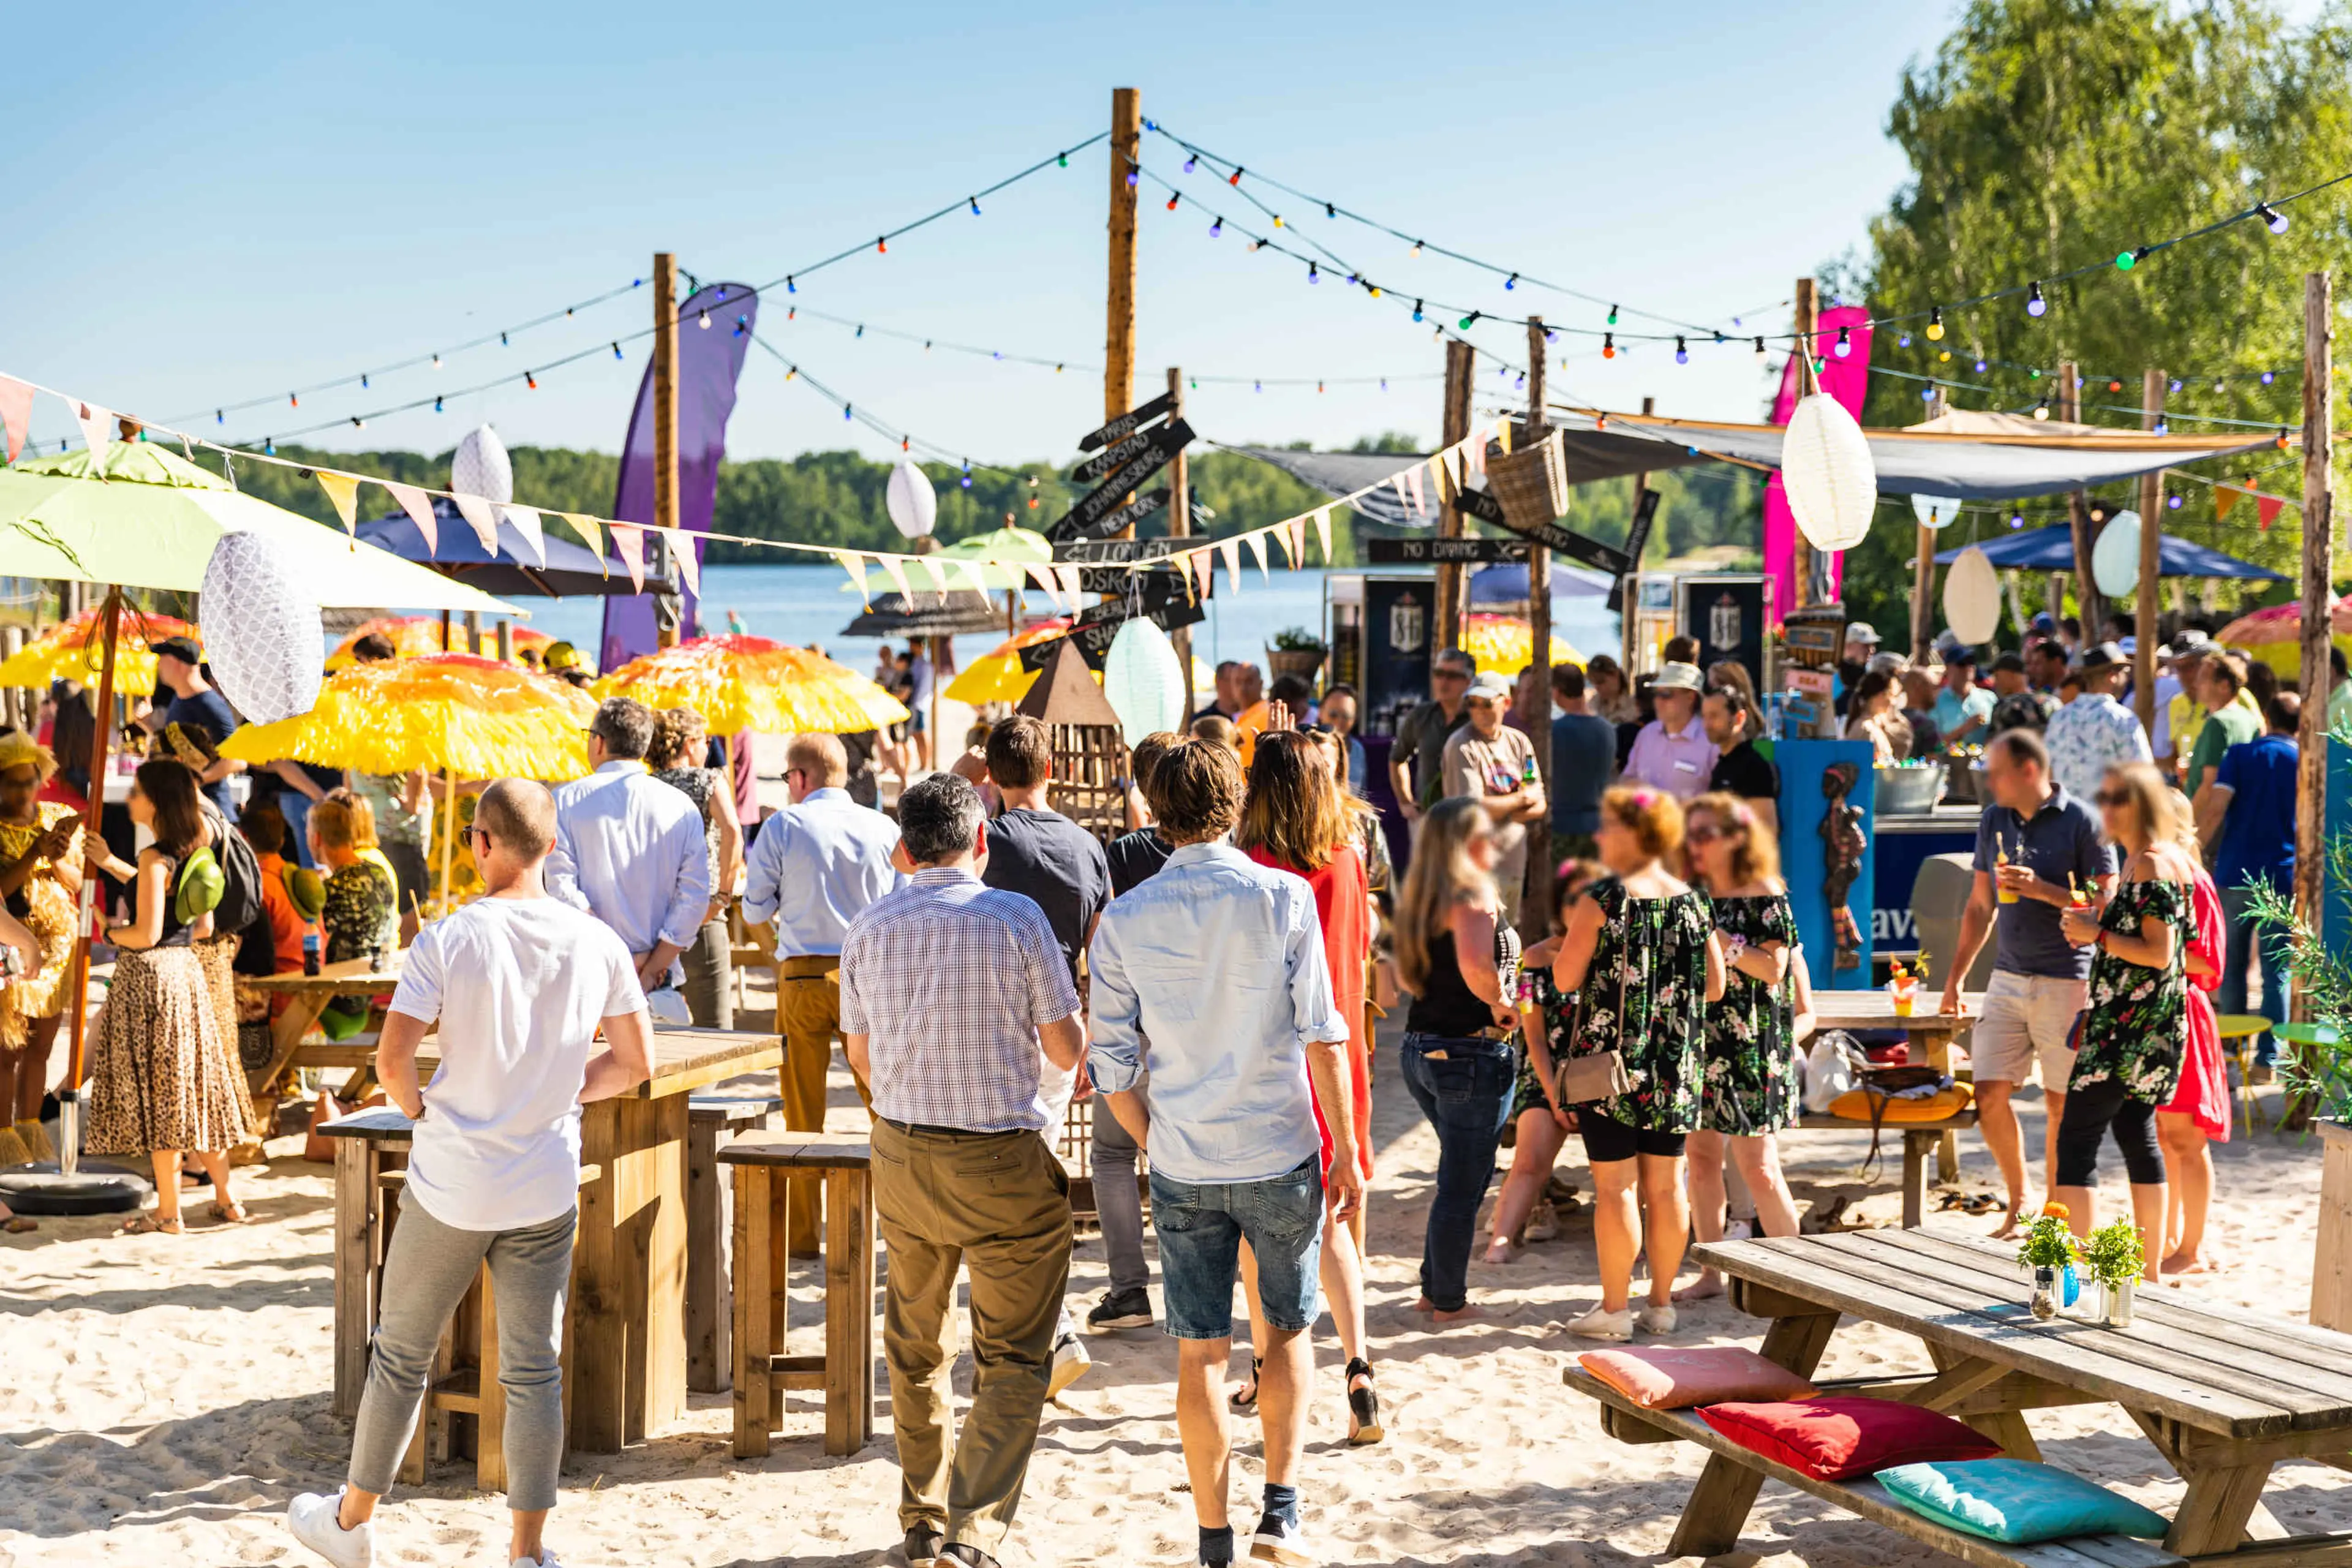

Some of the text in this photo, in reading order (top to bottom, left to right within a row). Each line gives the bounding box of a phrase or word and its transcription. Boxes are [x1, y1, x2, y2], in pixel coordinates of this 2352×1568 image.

[1084, 432, 1150, 478] KAAPSTAD
[1099, 495, 1161, 537] NEW YORK
[1403, 541, 1479, 559] NO DIVING
